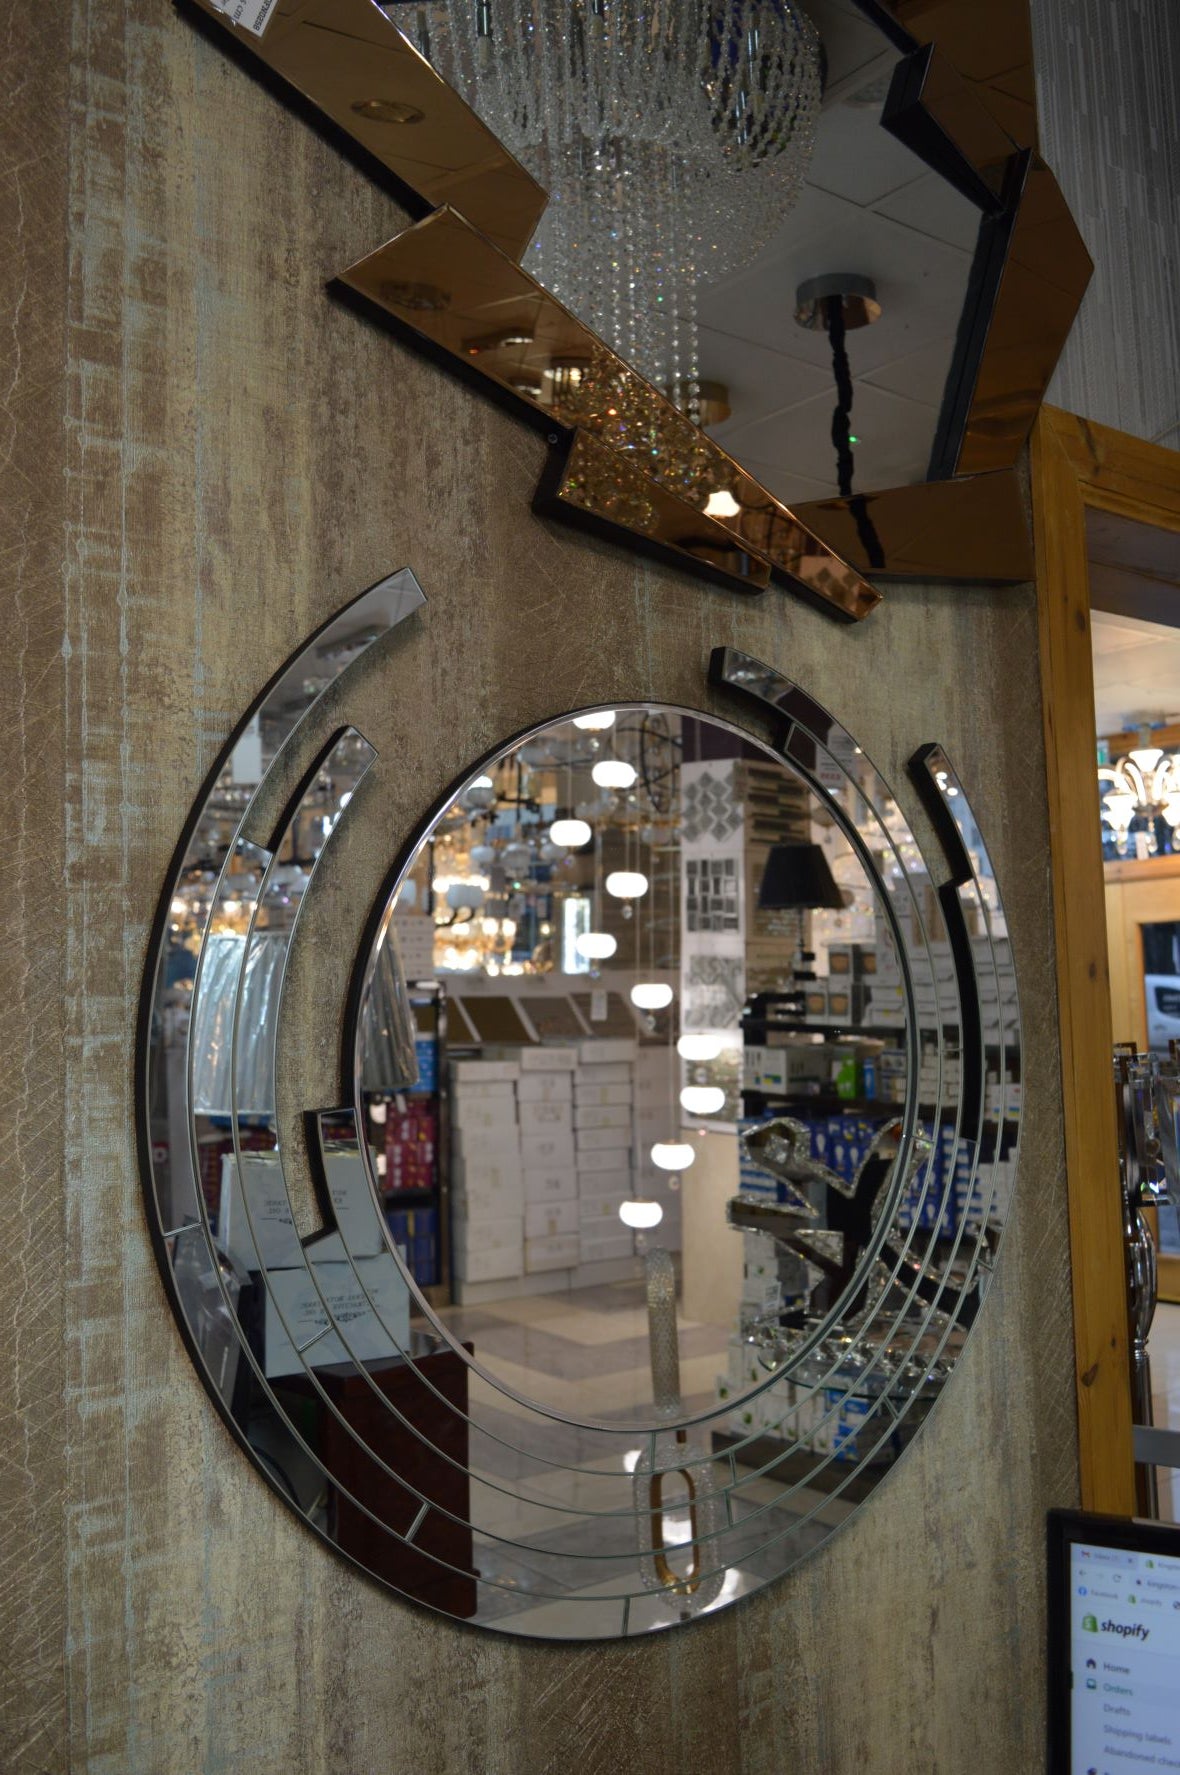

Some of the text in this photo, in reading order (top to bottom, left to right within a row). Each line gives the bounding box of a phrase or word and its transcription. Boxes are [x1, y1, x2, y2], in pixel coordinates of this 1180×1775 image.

[1101, 1619, 1150, 1641] shopify
[1103, 1661, 1130, 1674] Home
[1103, 1682, 1133, 1696] Orders
[1103, 1703, 1131, 1716] Drafts
[1103, 1724, 1143, 1742] Shipping
[1104, 1745, 1156, 1763] Abandoned
